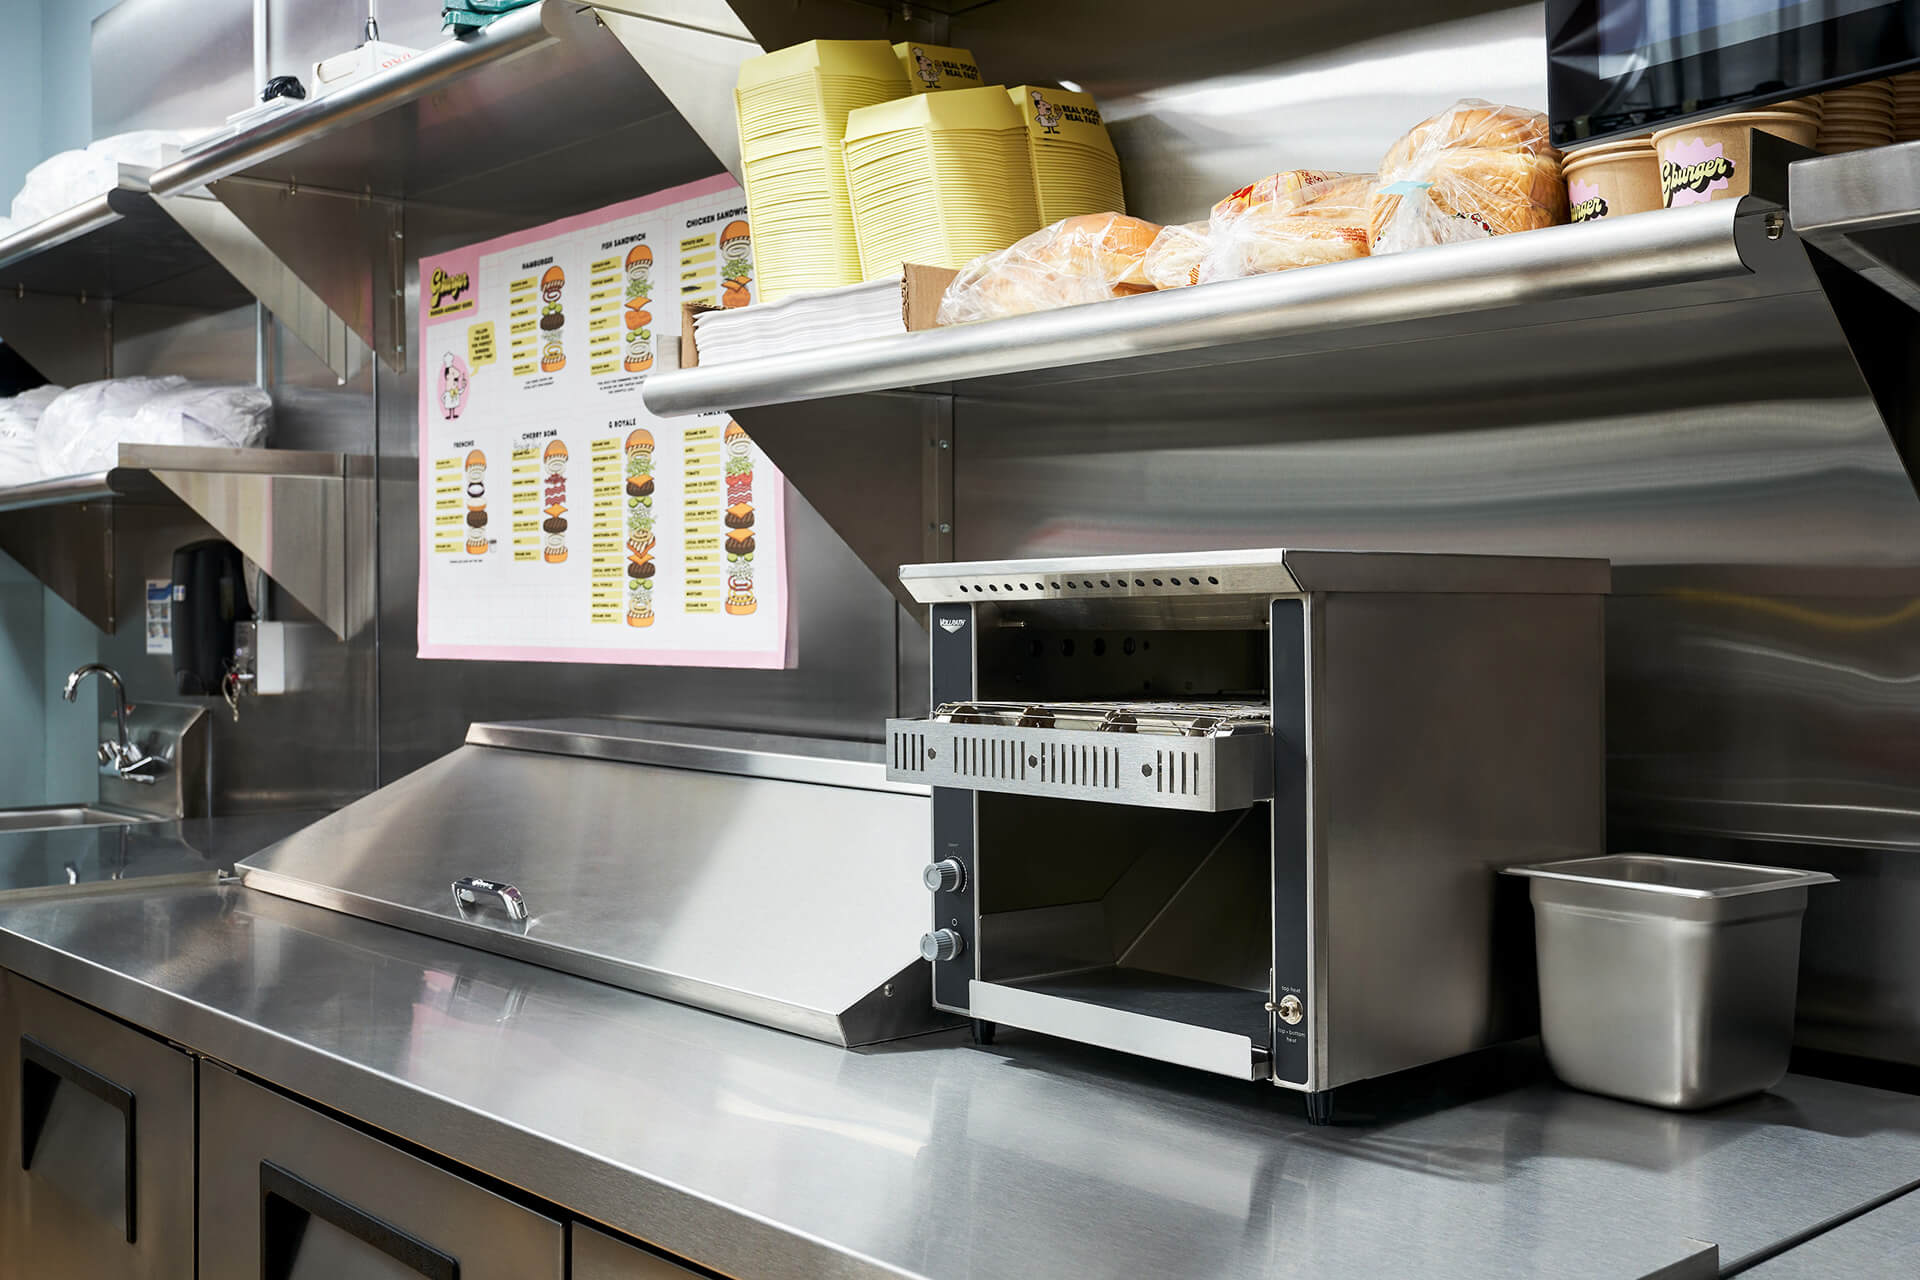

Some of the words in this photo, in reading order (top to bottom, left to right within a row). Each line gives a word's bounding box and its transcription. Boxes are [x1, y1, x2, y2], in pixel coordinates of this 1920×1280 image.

[942, 61, 960, 70] REAL
[961, 64, 978, 73] FOOD
[945, 69, 963, 78] REAL
[963, 72, 978, 80] FAST
[1061, 105, 1081, 114] REAL
[1081, 107, 1100, 118] FOOD
[1064, 113, 1083, 122] REAL
[1084, 115, 1100, 126] FAST
[686, 215, 715, 229] CHICKEN
[716, 206, 748, 221] SANDWIC
[601, 241, 613, 250] FISH
[614, 232, 646, 247] SANDWICH
[522, 256, 554, 269] HAMBURGER
[614, 418, 636, 427] ROYALE
[522, 431, 541, 440] CHERRY
[543, 429, 558, 437] BOMB
